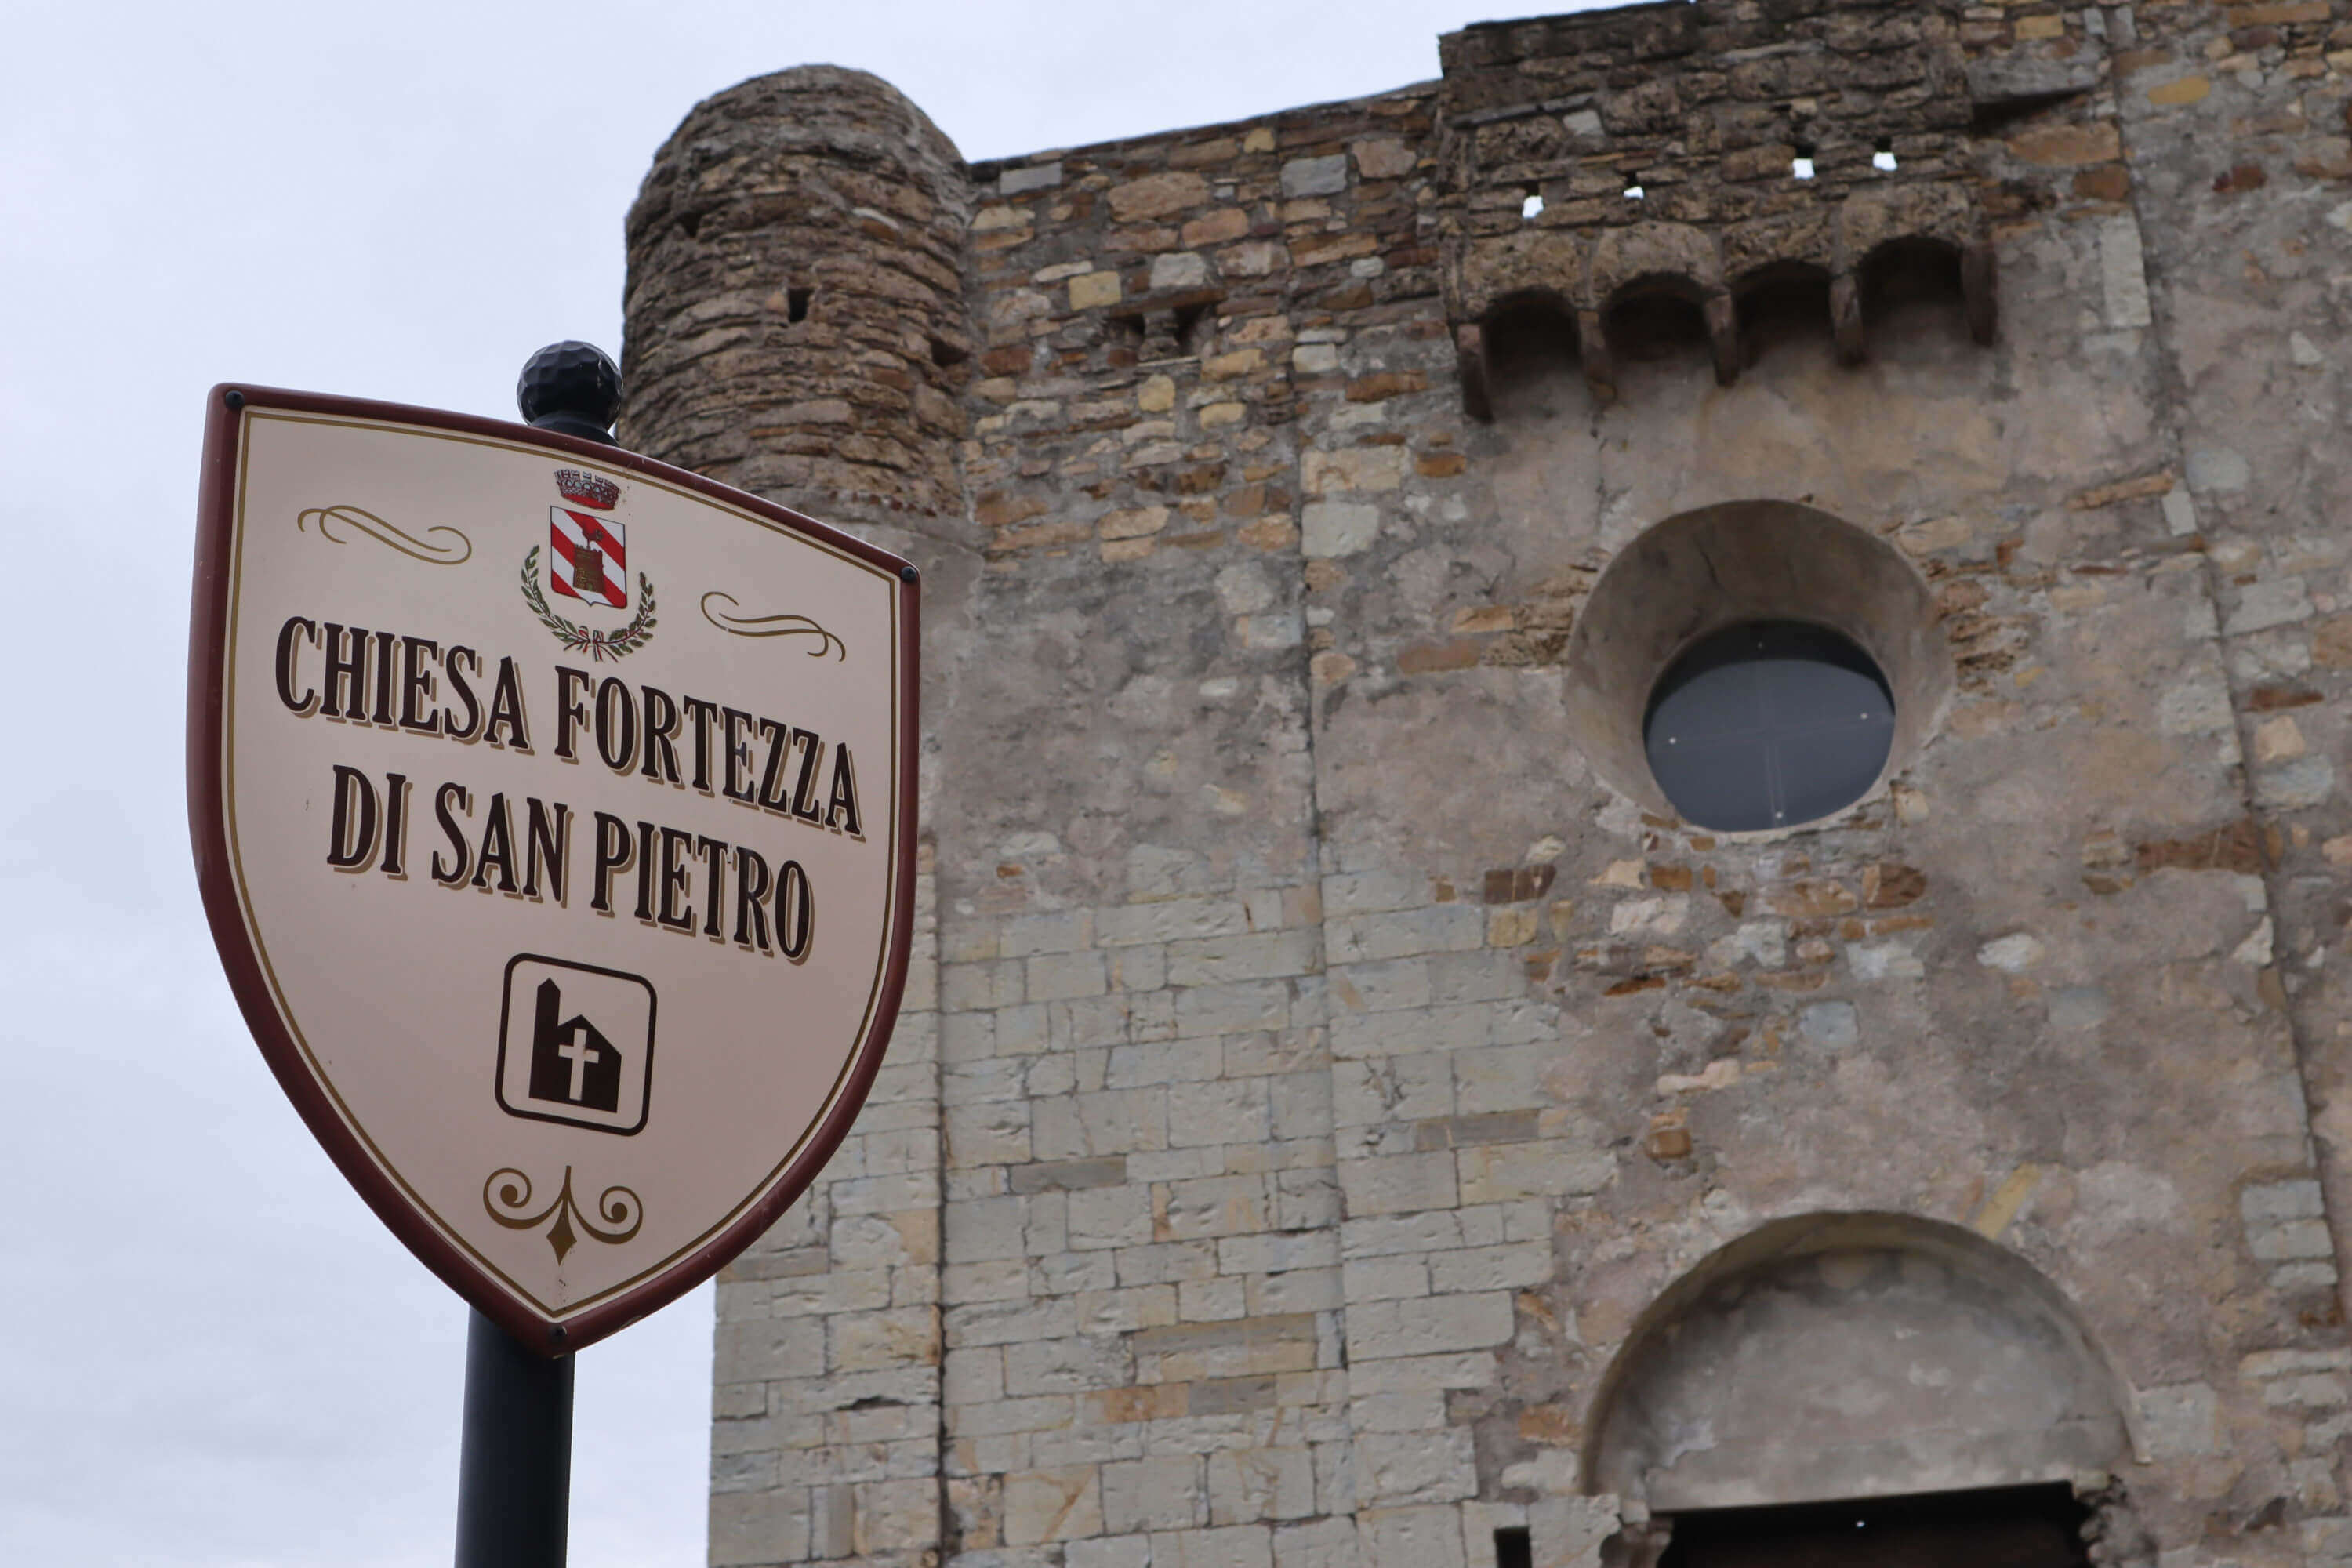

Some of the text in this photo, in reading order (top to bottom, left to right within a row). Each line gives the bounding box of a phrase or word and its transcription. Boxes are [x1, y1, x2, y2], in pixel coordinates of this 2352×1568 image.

[274, 615, 864, 839] CHIESA FORTEZZA
[326, 764, 812, 963] DI SAN PIETRO
